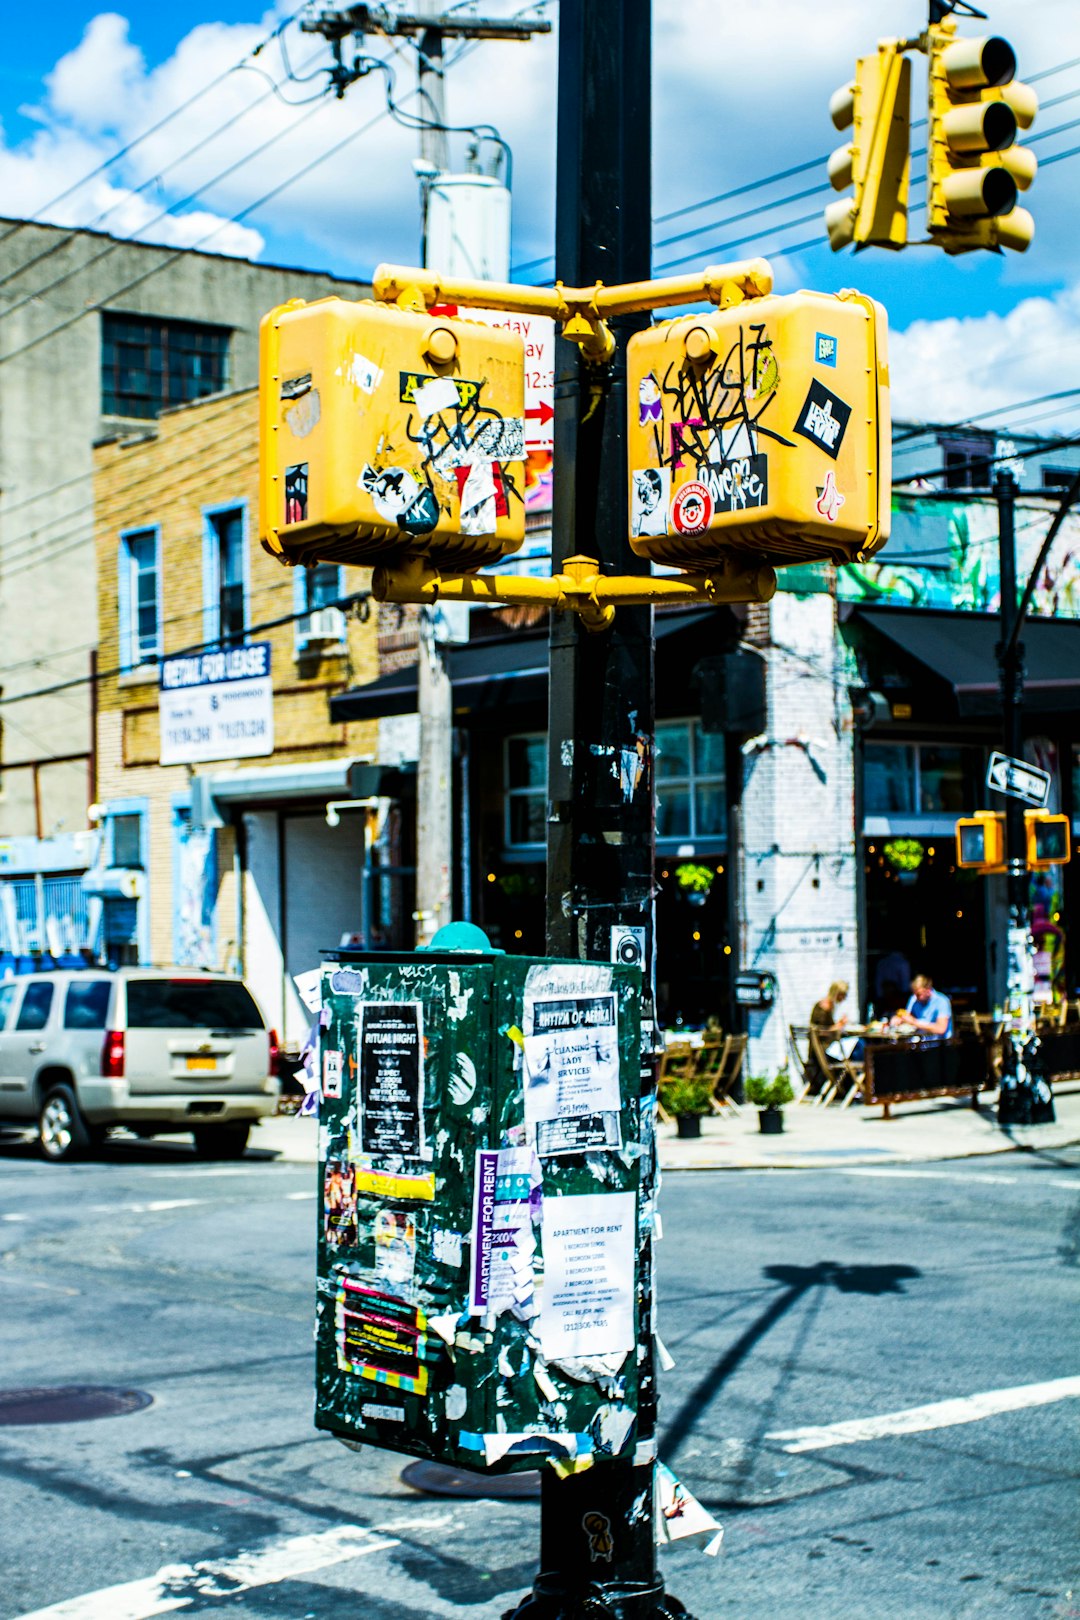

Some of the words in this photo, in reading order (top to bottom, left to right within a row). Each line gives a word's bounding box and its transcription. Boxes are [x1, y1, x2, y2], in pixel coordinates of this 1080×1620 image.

[676, 485, 707, 505] THURSDAY
[681, 522, 707, 536] FRIDAY
[225, 646, 267, 679] LEASE
[571, 1010, 584, 1024] OF
[365, 1032, 392, 1044] RITUAL
[392, 1033, 417, 1045] NIGHT
[554, 1044, 590, 1056] CLEANING
[561, 1056, 583, 1066] LADY
[558, 1067, 592, 1078] SERVICES
[483, 1159, 496, 1194] RENT
[482, 1199, 494, 1224] FOR
[553, 1227, 589, 1237] APARTMENT
[591, 1226, 605, 1234] FOR
[607, 1224, 623, 1233] RENT
[568, 1242, 590, 1250] BEDROOM
[480, 1226, 493, 1301] APARTMENT
[569, 1267, 593, 1275] BEDROOM
